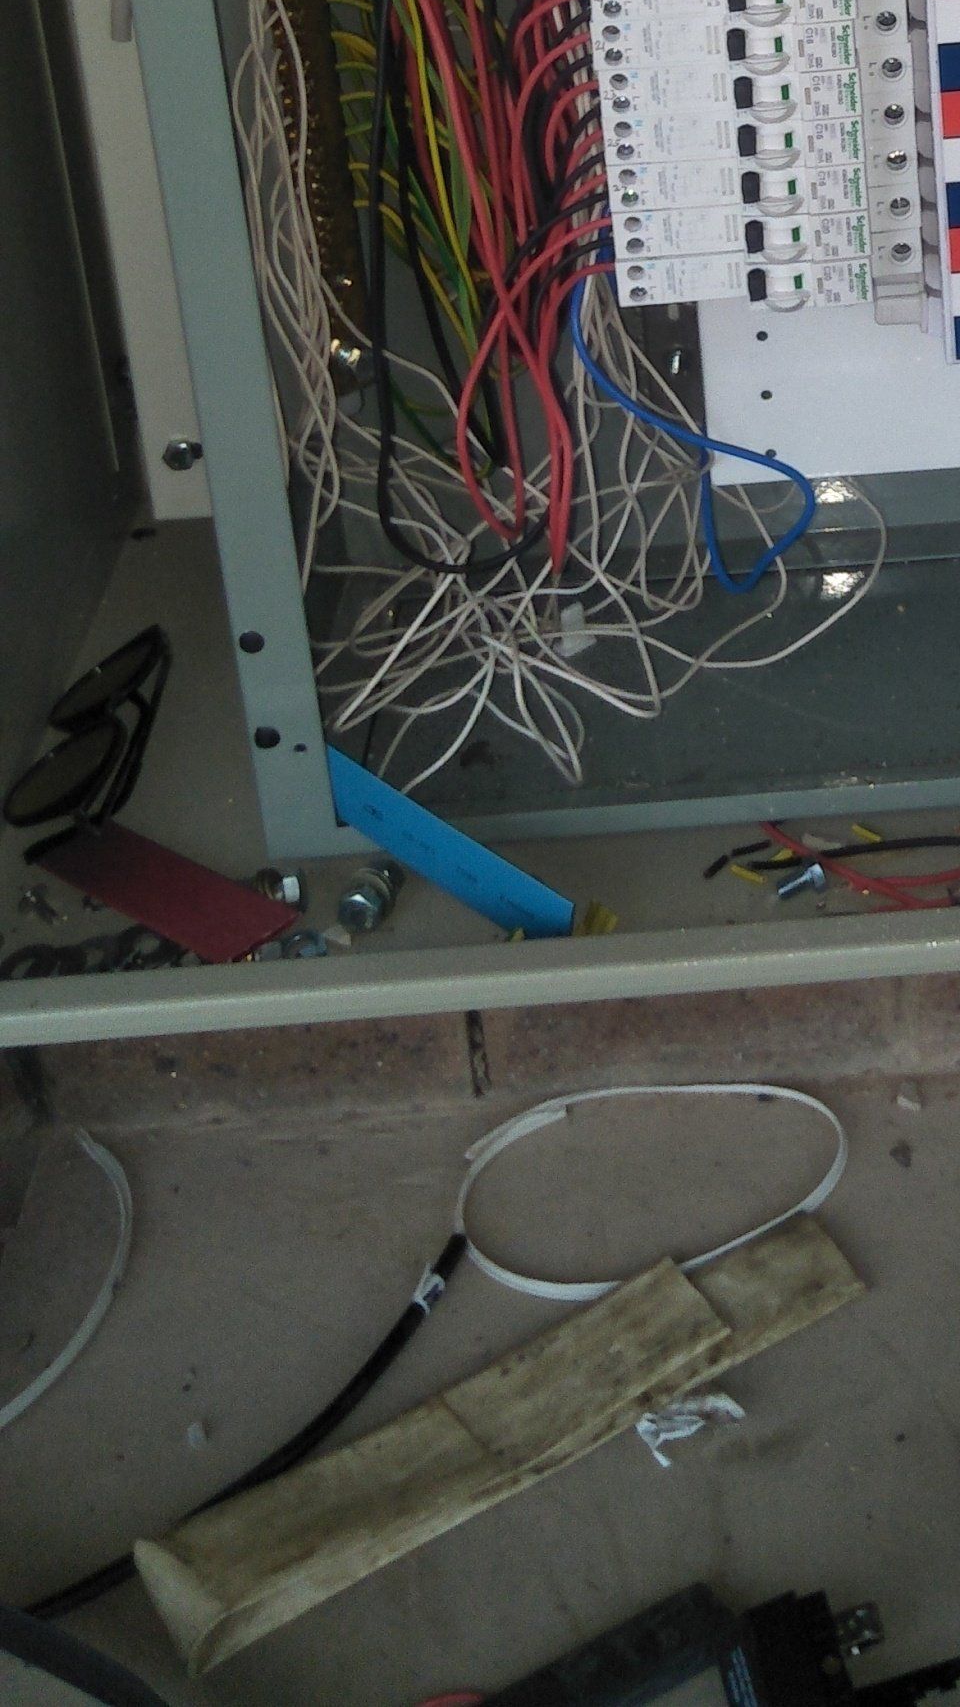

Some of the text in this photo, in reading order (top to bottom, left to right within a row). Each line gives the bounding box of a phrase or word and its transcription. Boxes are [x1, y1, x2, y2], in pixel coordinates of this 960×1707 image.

[842, 25, 851, 65] Schneider
[848, 72, 858, 112] Schneider
[851, 120, 860, 160] Schneider
[853, 168, 862, 207] Schneider
[857, 216, 866, 253] Schneider
[859, 263, 868, 301] Schneider
